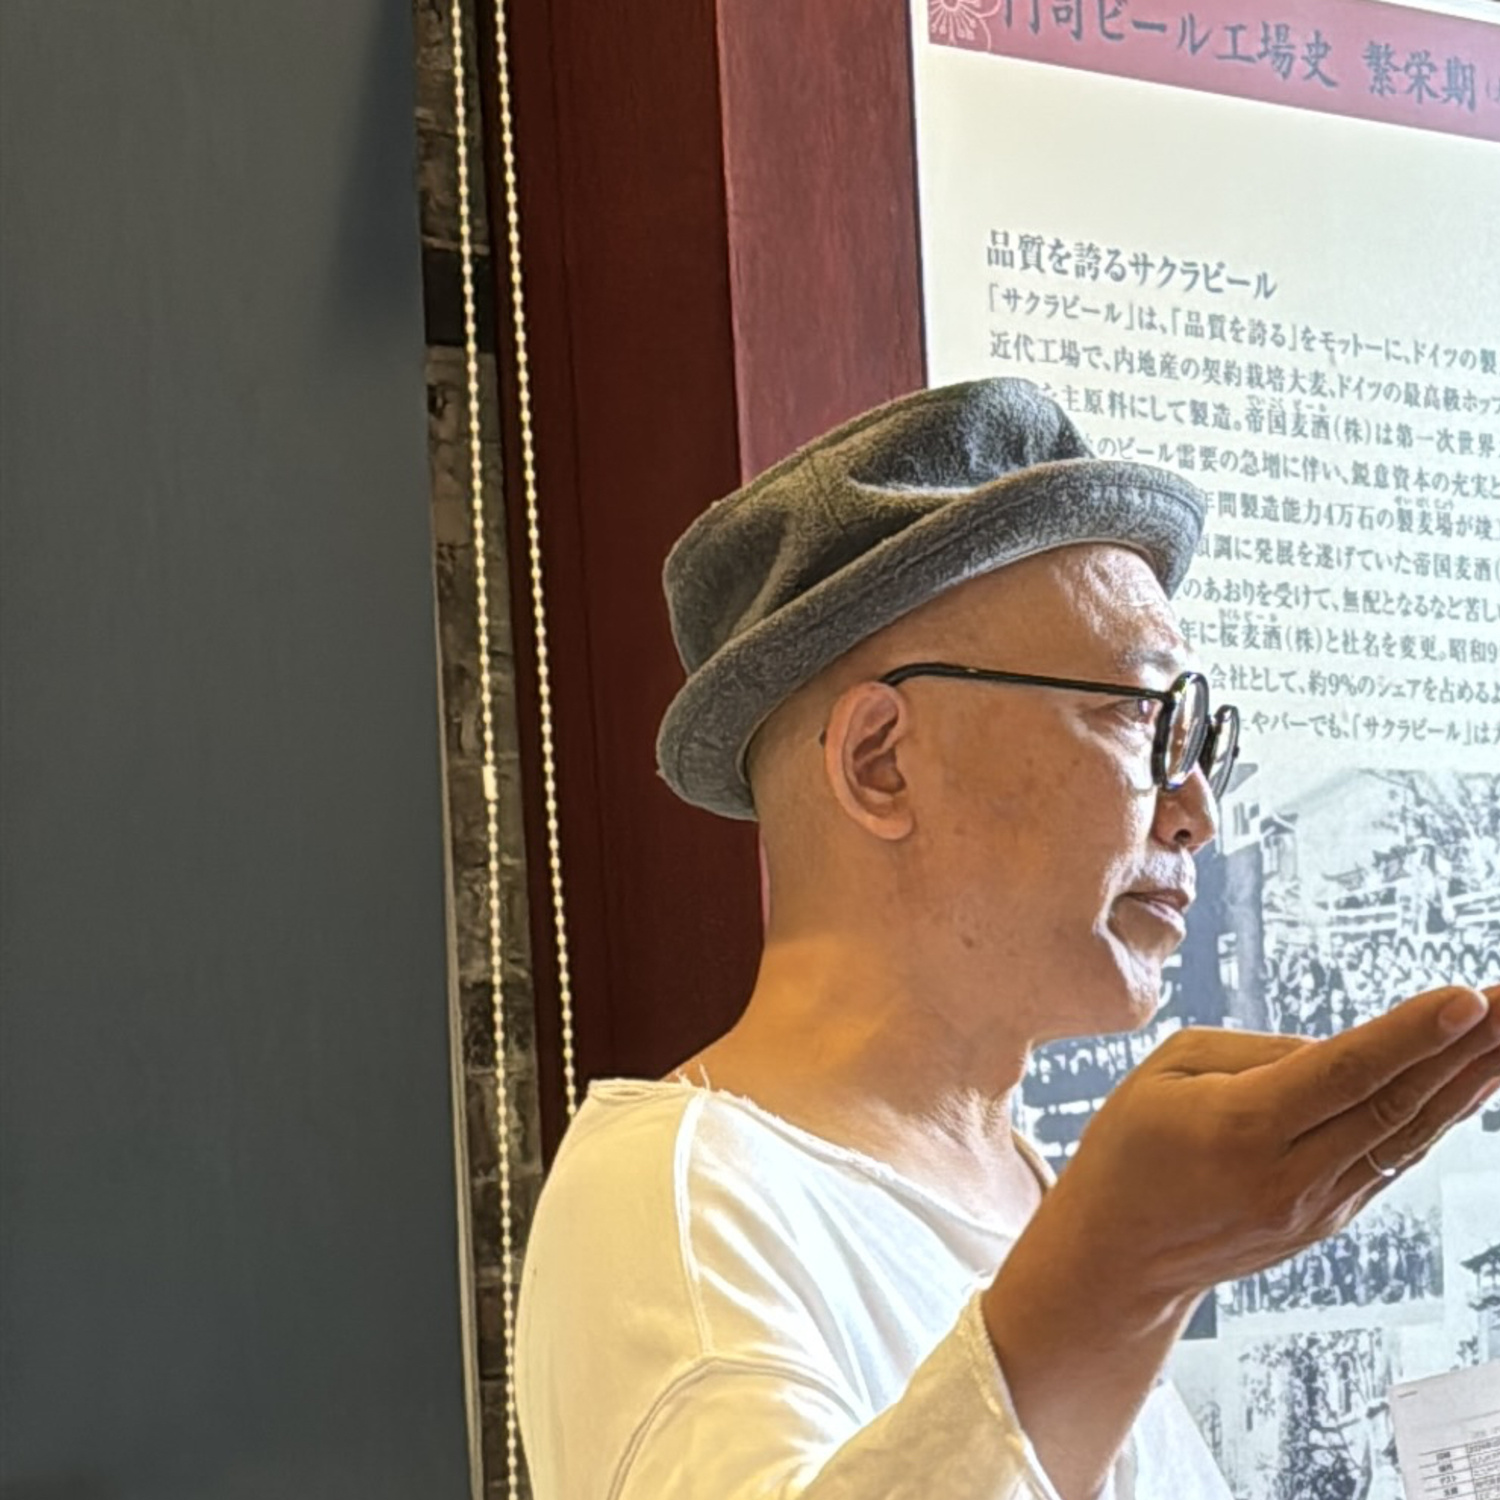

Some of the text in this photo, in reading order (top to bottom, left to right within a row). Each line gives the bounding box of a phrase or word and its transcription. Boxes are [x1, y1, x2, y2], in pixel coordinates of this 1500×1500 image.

[1362, 40, 1476, 113] 繁栄期
[986, 229, 1278, 299] 品質を誇るサクラビール
